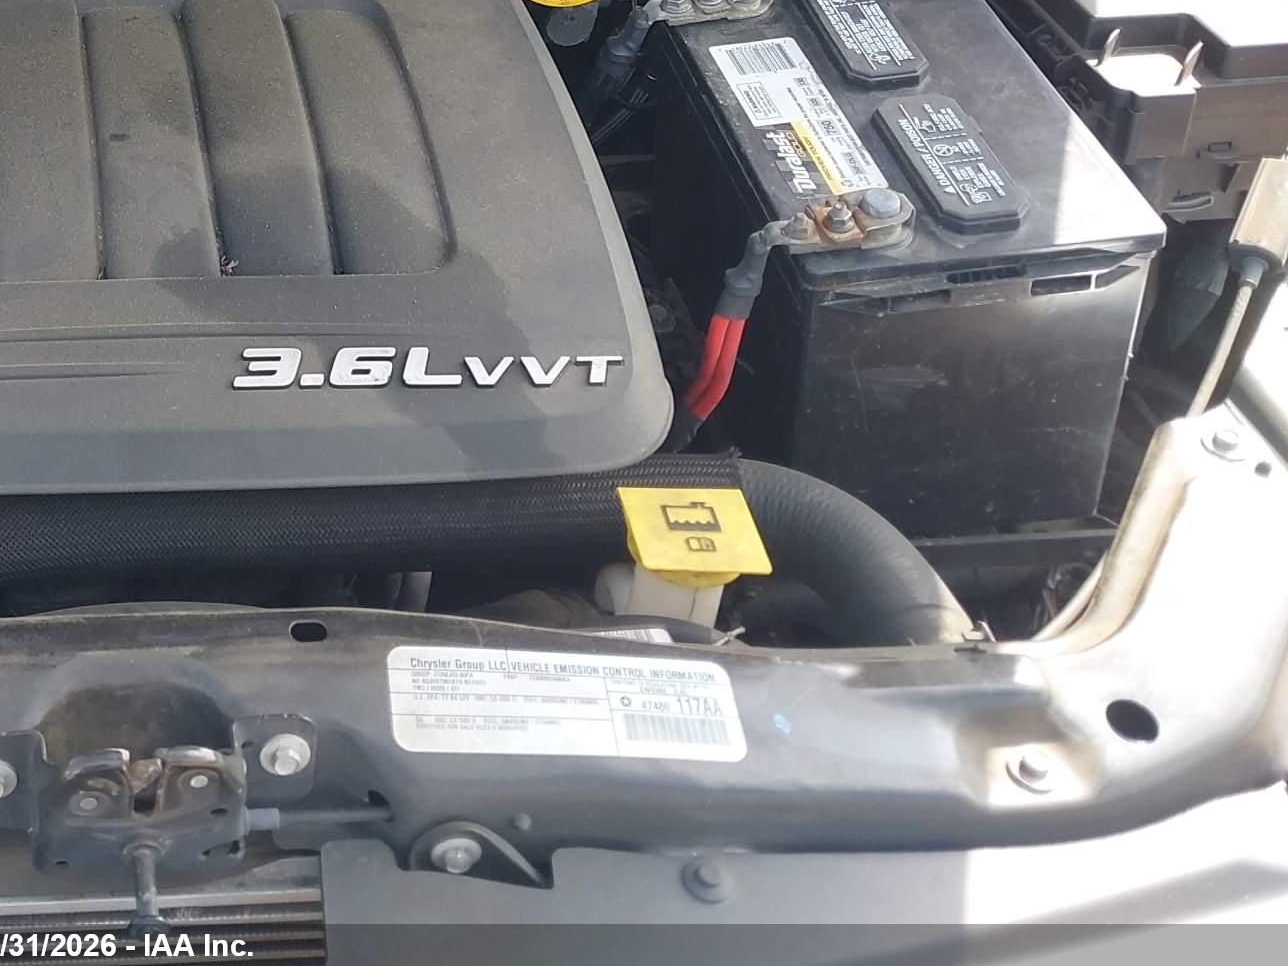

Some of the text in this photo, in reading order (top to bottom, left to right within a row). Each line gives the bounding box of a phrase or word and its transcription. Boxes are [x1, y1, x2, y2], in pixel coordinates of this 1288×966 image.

[820, 120, 837, 134] 750
[898, 119, 924, 148] POISON
[786, 131, 806, 158] GOLD
[766, 131, 816, 194] Duralast
[921, 154, 951, 186] DANGER
[232, 347, 624, 390] 3.6L VVT
[410, 657, 715, 683] Chrysler Group LLC VEHICLE EMISSION CONTROL INFORMATION
[676, 697, 723, 716] 117AA
